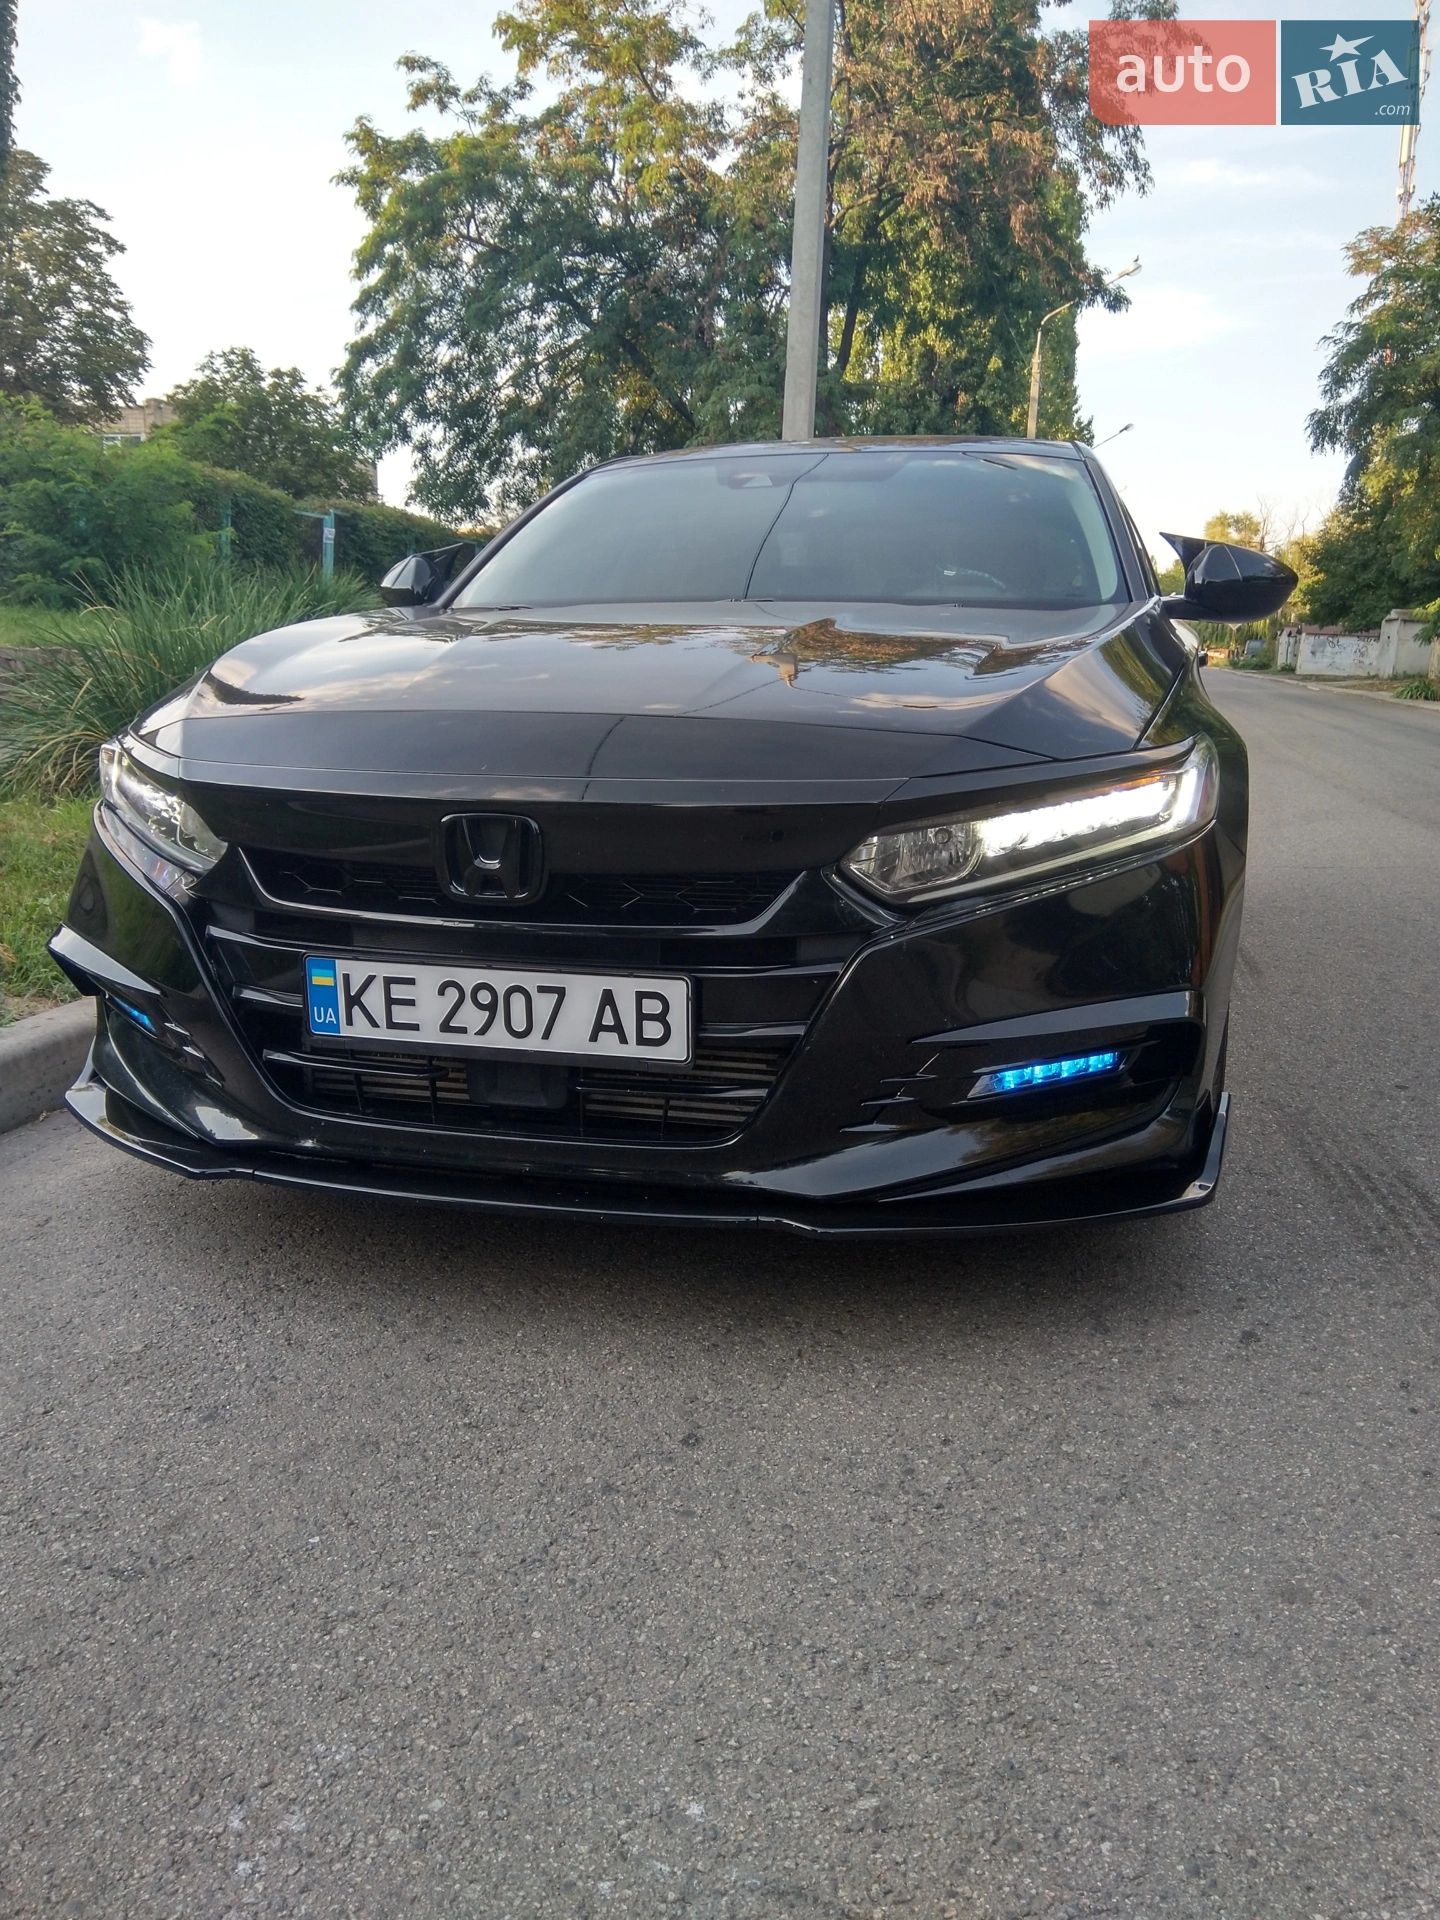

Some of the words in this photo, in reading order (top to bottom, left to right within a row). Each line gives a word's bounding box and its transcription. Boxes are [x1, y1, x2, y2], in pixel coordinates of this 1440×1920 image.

[314, 1006, 337, 1025] UA
[342, 972, 421, 1032] KE
[436, 979, 567, 1040] 2907
[588, 988, 672, 1047] AB
